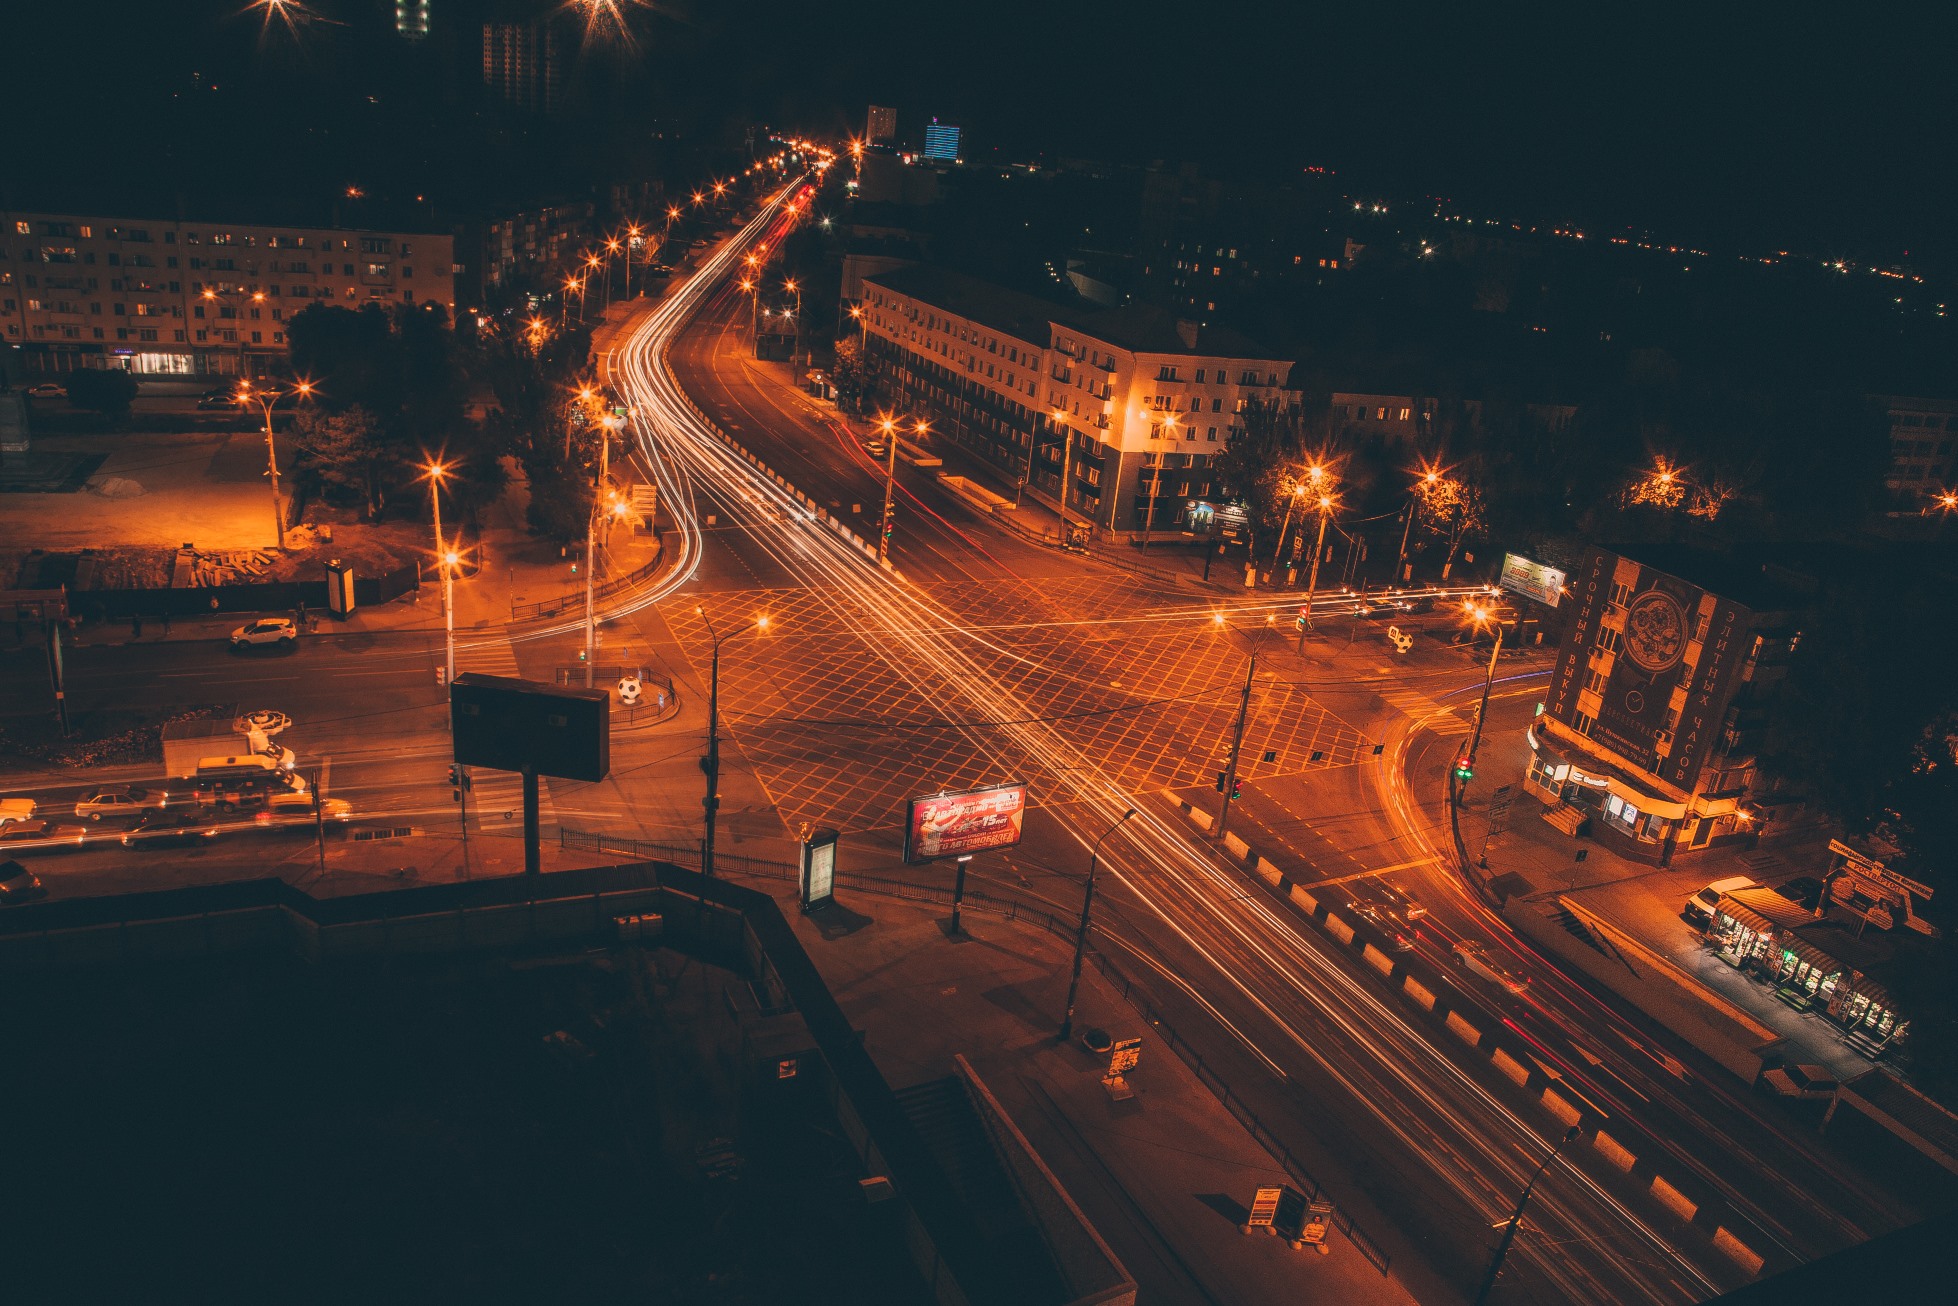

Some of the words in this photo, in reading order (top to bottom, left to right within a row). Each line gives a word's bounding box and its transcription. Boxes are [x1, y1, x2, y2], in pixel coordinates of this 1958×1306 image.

[1573, 555, 1604, 646] СРОЧНЫЙ
[1553, 653, 1578, 716] ВЫКУП
[1697, 610, 1737, 707] ЭЛИТНЫХ
[1674, 714, 1704, 781] ЧАСОВ
